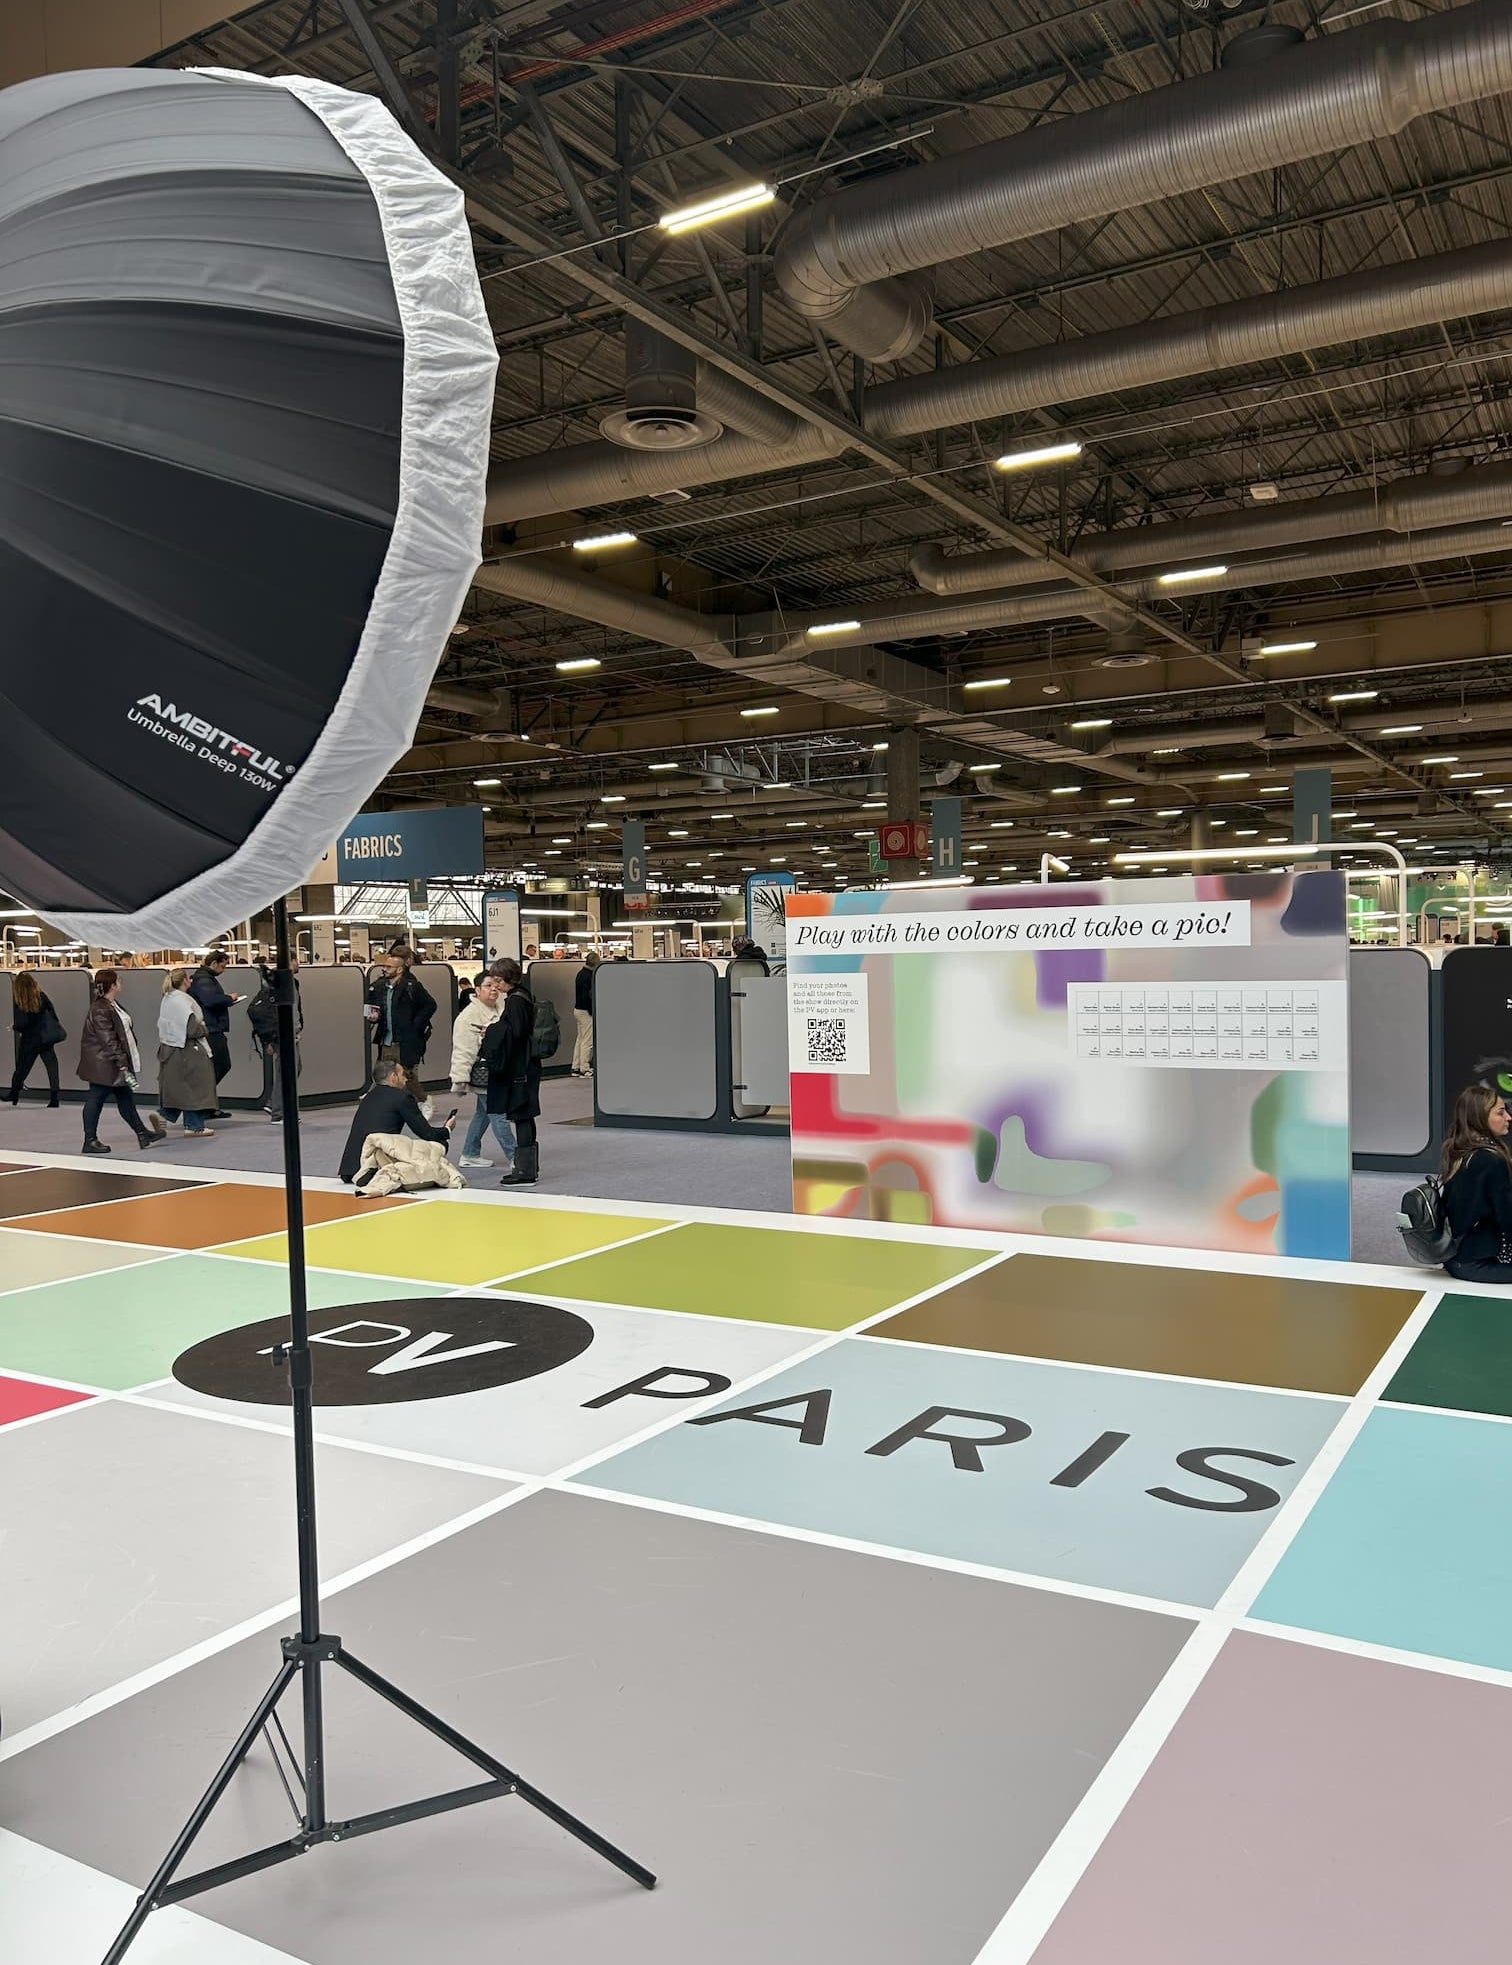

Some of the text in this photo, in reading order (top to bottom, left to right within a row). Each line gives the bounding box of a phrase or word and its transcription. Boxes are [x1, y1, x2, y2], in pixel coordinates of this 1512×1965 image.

[127, 708, 278, 792] Umbrella Deep 130W
[344, 834, 403, 860] FABRICS
[938, 836, 954, 867] H
[629, 856, 640, 882] G
[488, 907, 499, 917] 6J1
[795, 912, 1232, 949] Play with the colors and take a pic!
[825, 982, 848, 990] photos
[256, 1320, 1296, 1513] PV PARIS
